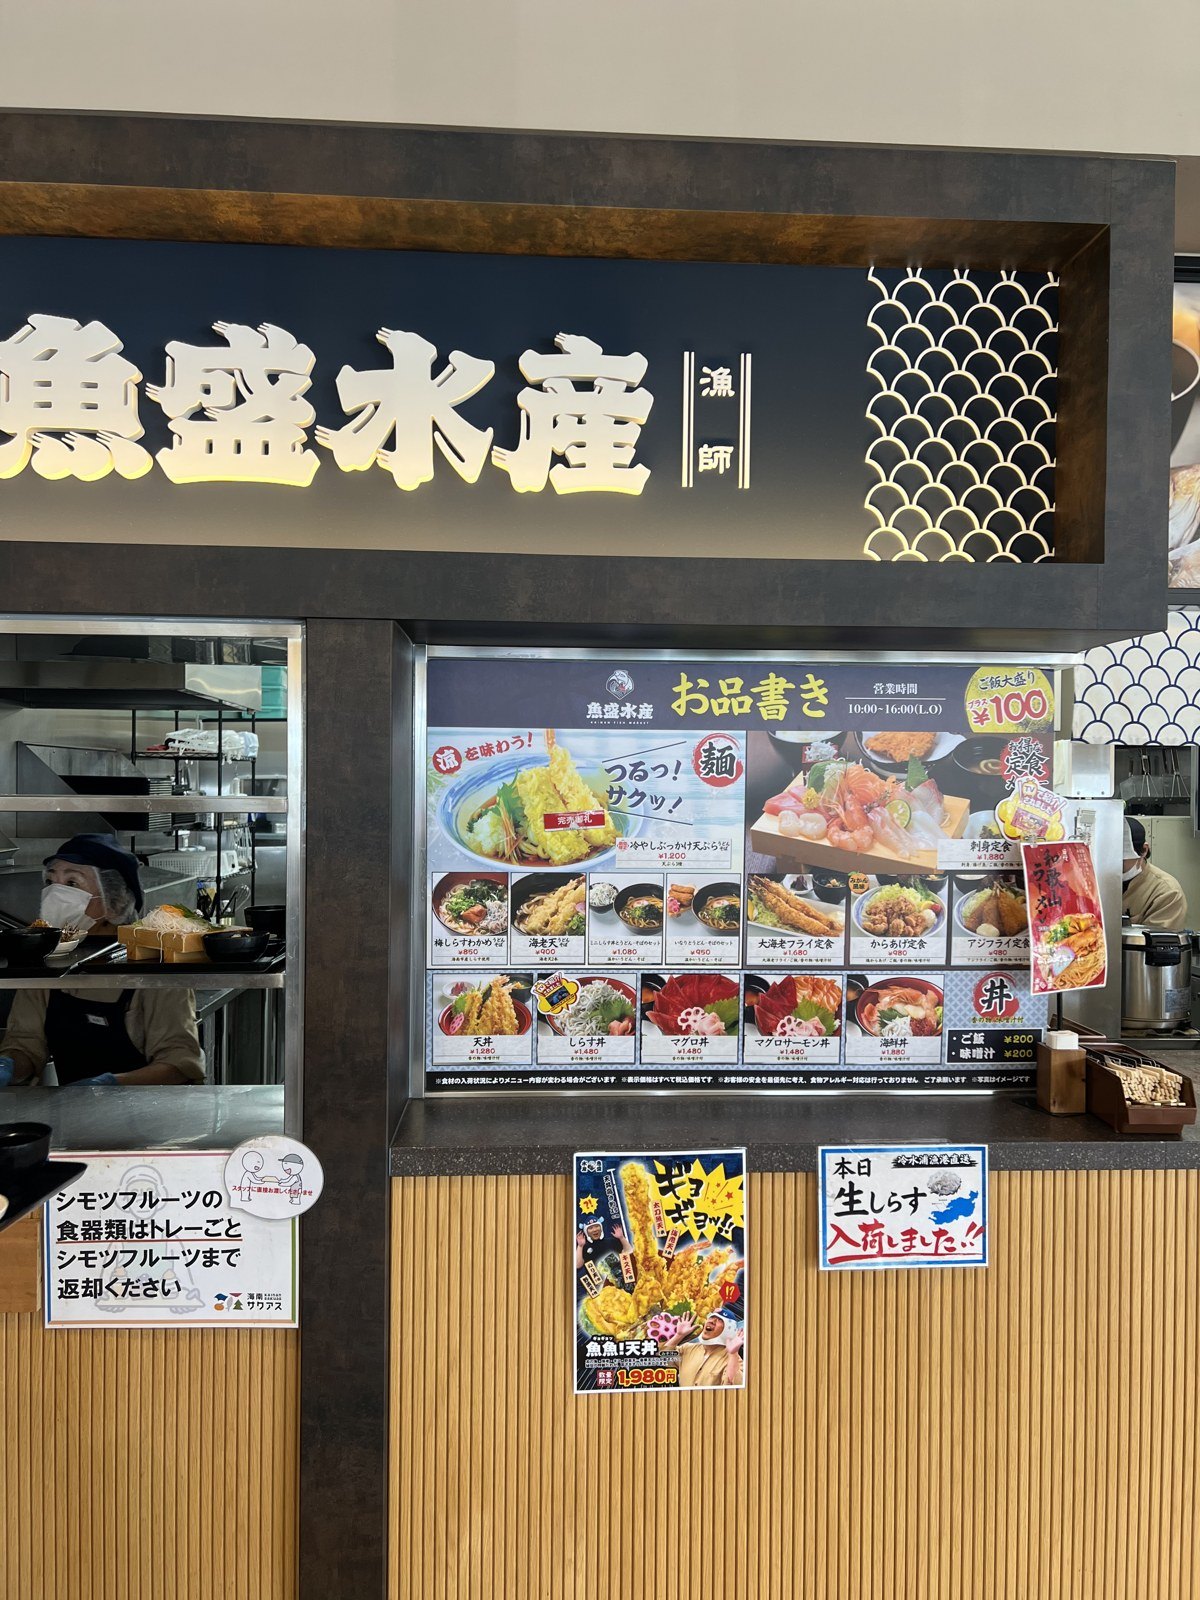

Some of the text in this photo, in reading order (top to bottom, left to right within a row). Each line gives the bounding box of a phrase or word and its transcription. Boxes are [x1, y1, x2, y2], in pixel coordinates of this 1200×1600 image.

[0, 313, 653, 495] 魚盛水産
[699, 366, 735, 474] 漁師
[873, 682, 918, 695] 営業時間
[979, 670, 1035, 690] ご飯大盛り
[671, 672, 829, 721] お品書き
[967, 698, 988, 709] プラス
[586, 701, 654, 719] 魚盛水産
[971, 689, 1048, 726] ¥100
[700, 741, 737, 778] 麺
[1004, 751, 1050, 777] 定食
[604, 759, 682, 783] つるっ!
[605, 785, 683, 815] サクッ!
[557, 814, 593, 826] 完売御礼
[970, 841, 1012, 852] 刺身定食
[434, 938, 492, 947] 梅しらすわかめ
[528, 938, 559, 948] 海老天
[758, 938, 835, 949] 大海老フライ定食
[871, 938, 928, 949] からあげ定食
[981, 977, 1013, 1014] 丼
[473, 1037, 493, 1047] 天丼
[569, 1037, 606, 1047] しらす丼
[670, 1036, 710, 1047] マグロ丼
[755, 1037, 830, 1048] マグロサーモン丼
[879, 1038, 909, 1048] 海鮮丼
[961, 1032, 1034, 1045] ご飯 ¥200
[959, 1047, 1033, 1060] 味噌汁 ¥200
[833, 1156, 872, 1180] 本日
[898, 1153, 972, 1166] 冷水浦漁港直送
[56, 1190, 223, 1212] シモツフルーツの
[833, 1181, 928, 1217] 生しらす
[56, 1217, 243, 1241] 食器類はトレーごと
[56, 1248, 241, 1270] シモツフルーツまで
[57, 1277, 182, 1300] 返却ください
[247, 1292, 263, 1300] 海南
[247, 1301, 282, 1311] サクアス
[586, 1341, 657, 1358] 魚魚!天丼
[617, 1368, 677, 1387] 1,980円
